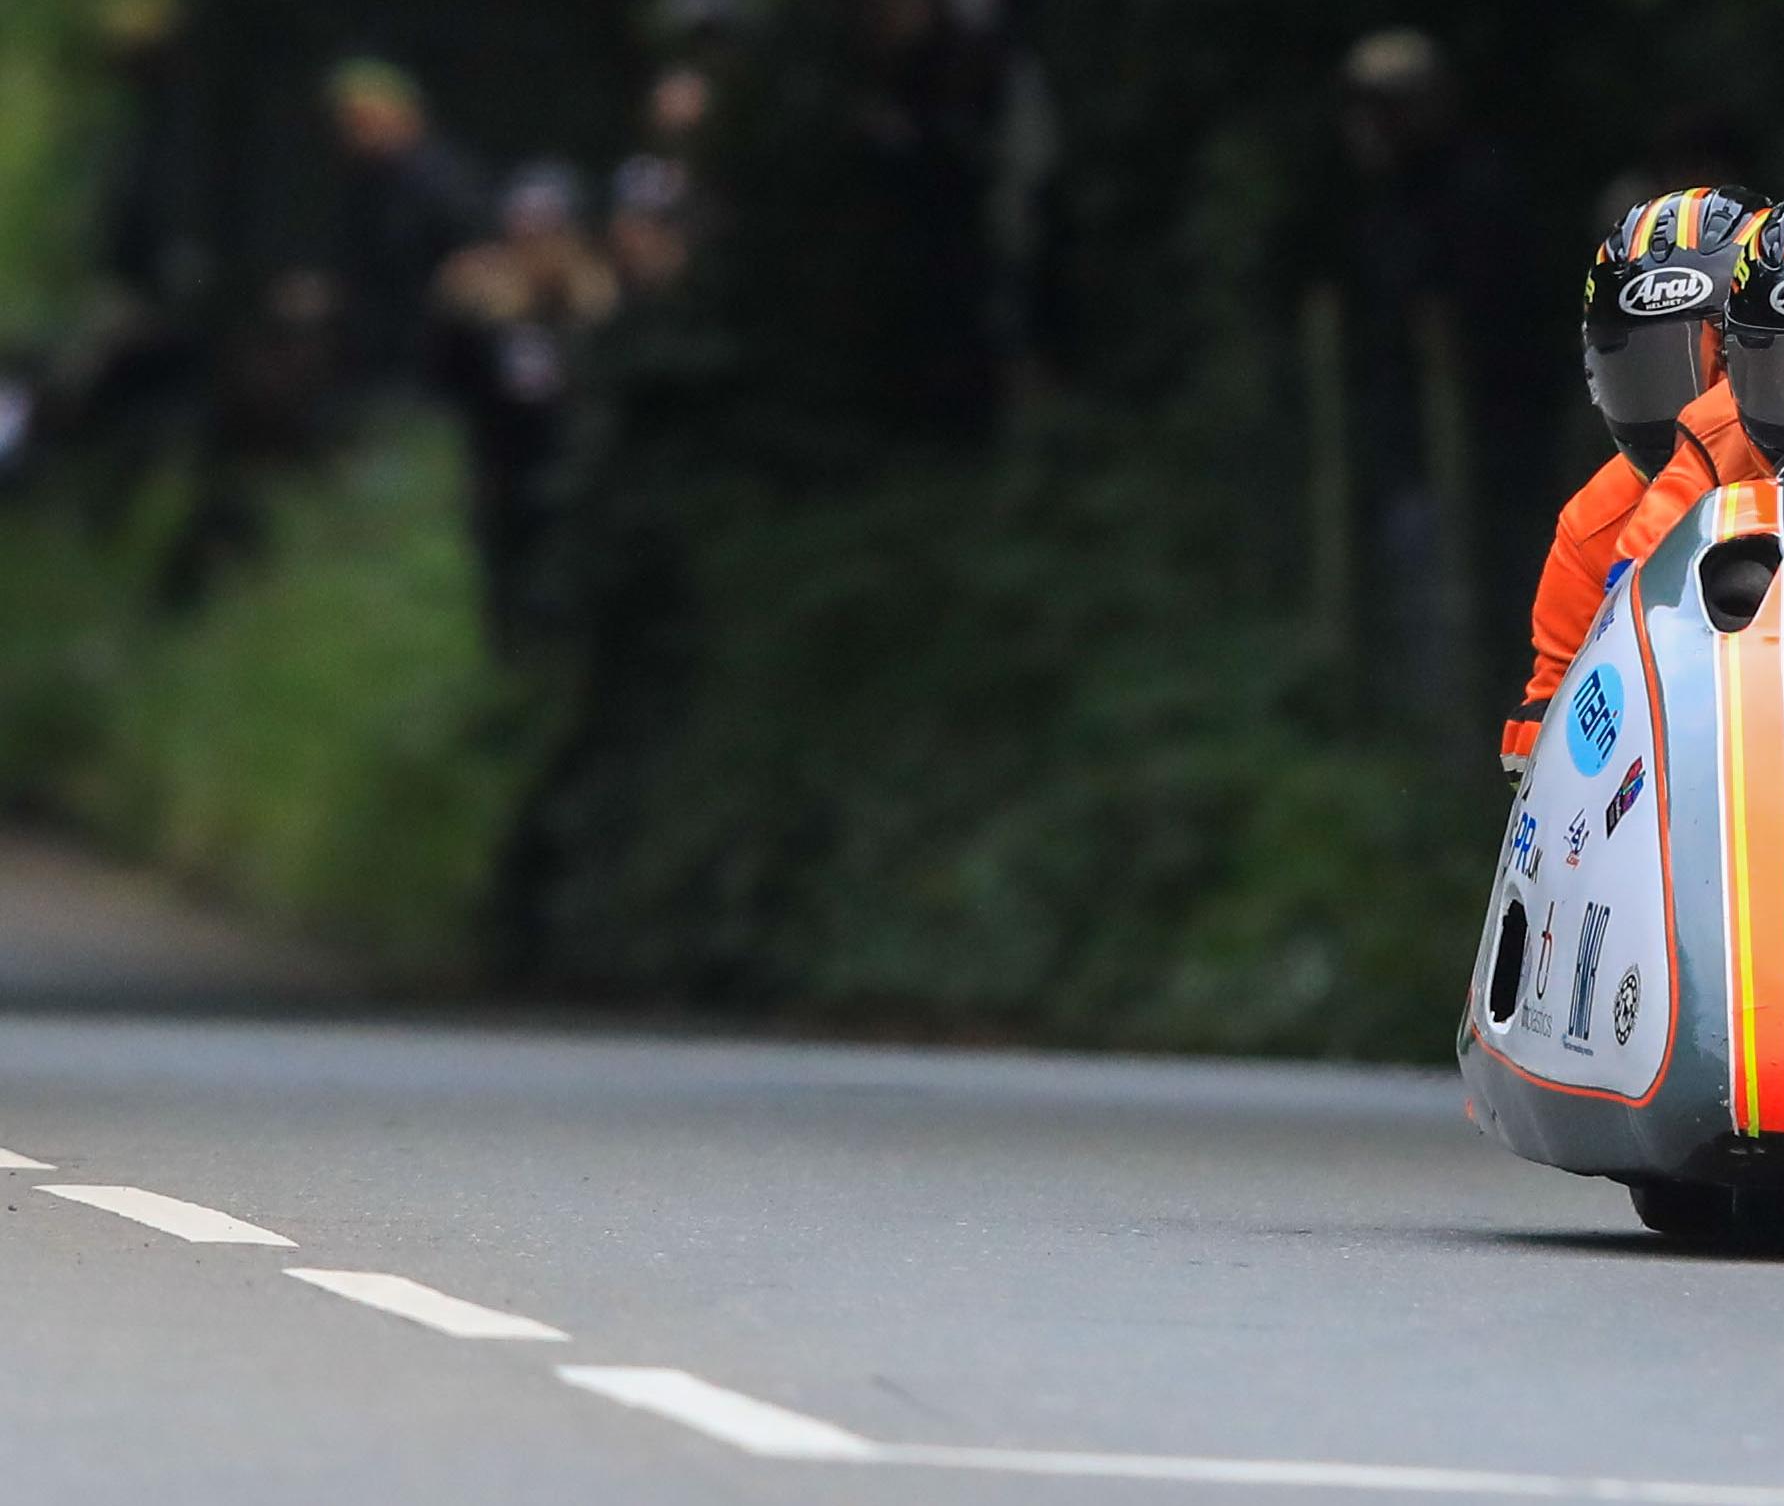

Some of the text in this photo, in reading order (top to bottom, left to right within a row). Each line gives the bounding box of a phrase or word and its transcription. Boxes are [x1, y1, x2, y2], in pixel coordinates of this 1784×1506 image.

[1629, 273, 1701, 304] Arai
[1646, 298, 1682, 311] HELMET
[1573, 669, 1617, 760] marin
